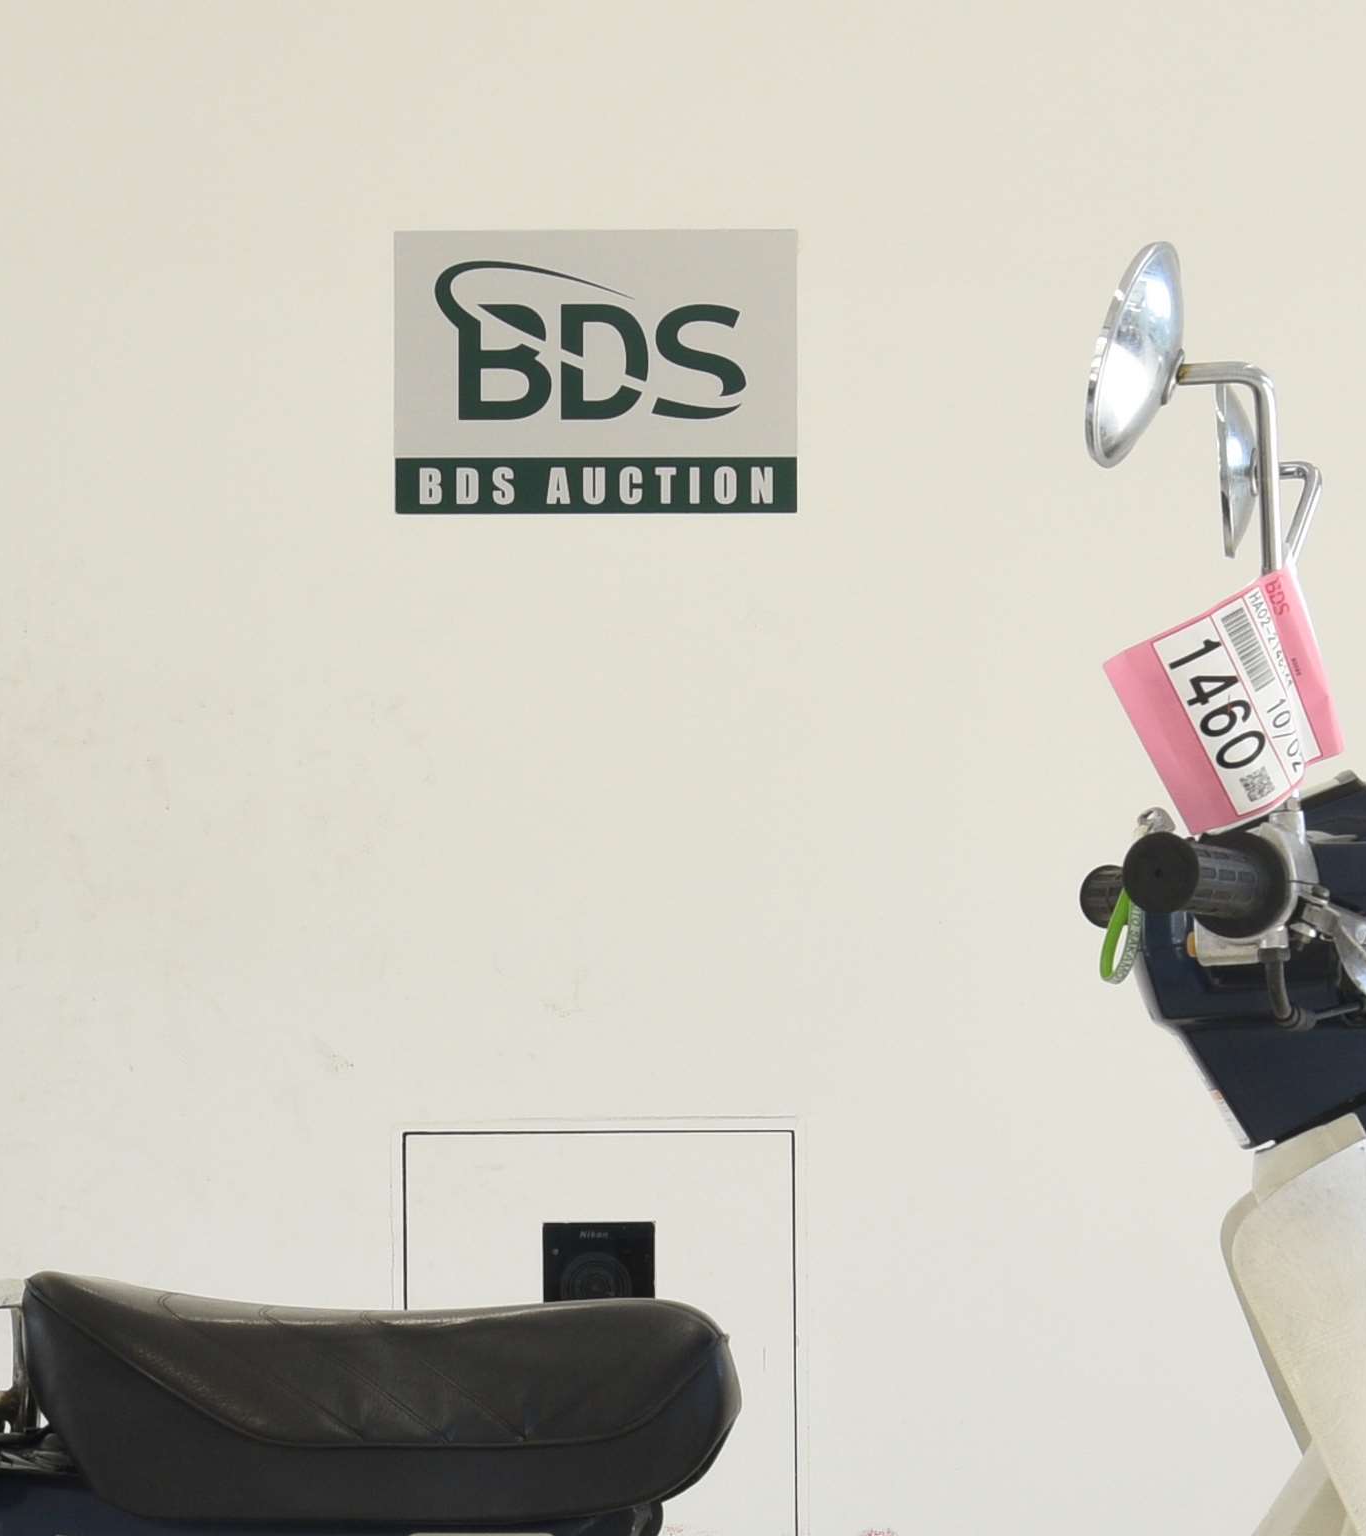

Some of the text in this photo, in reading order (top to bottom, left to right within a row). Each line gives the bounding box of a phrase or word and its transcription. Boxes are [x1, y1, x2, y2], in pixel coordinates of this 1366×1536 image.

[435, 261, 746, 420] BDS
[419, 467, 773, 504] BDS AUCTION
[1168, 639, 1266, 770] 1460
